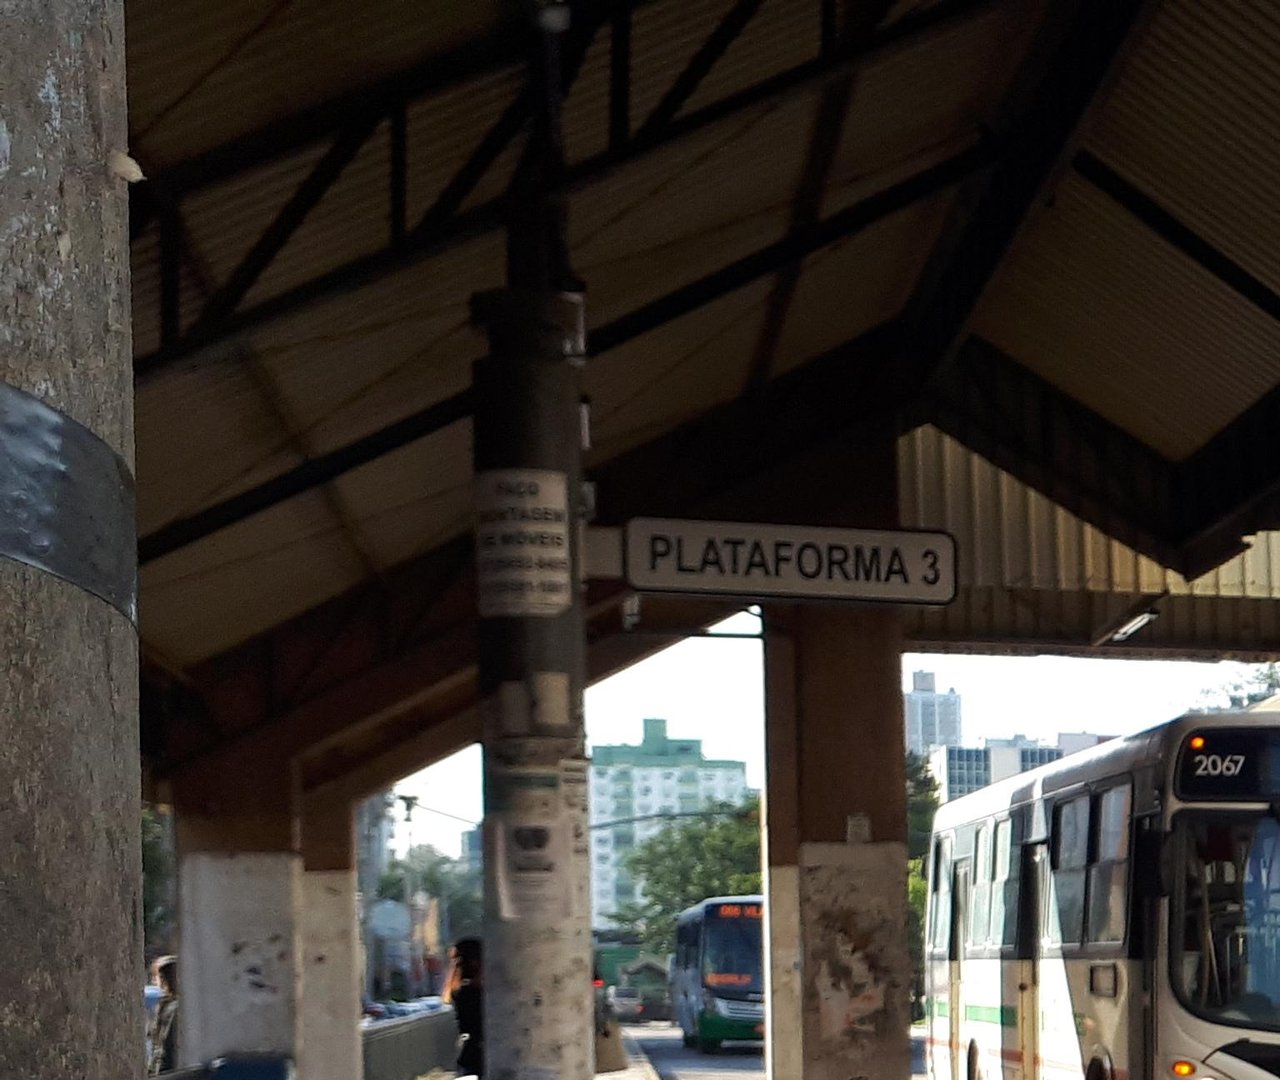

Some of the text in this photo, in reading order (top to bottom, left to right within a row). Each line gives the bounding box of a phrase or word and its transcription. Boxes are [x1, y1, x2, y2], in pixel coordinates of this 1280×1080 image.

[649, 533, 941, 585] PLATAFORMA 3
[1194, 755, 1246, 776] 2067
